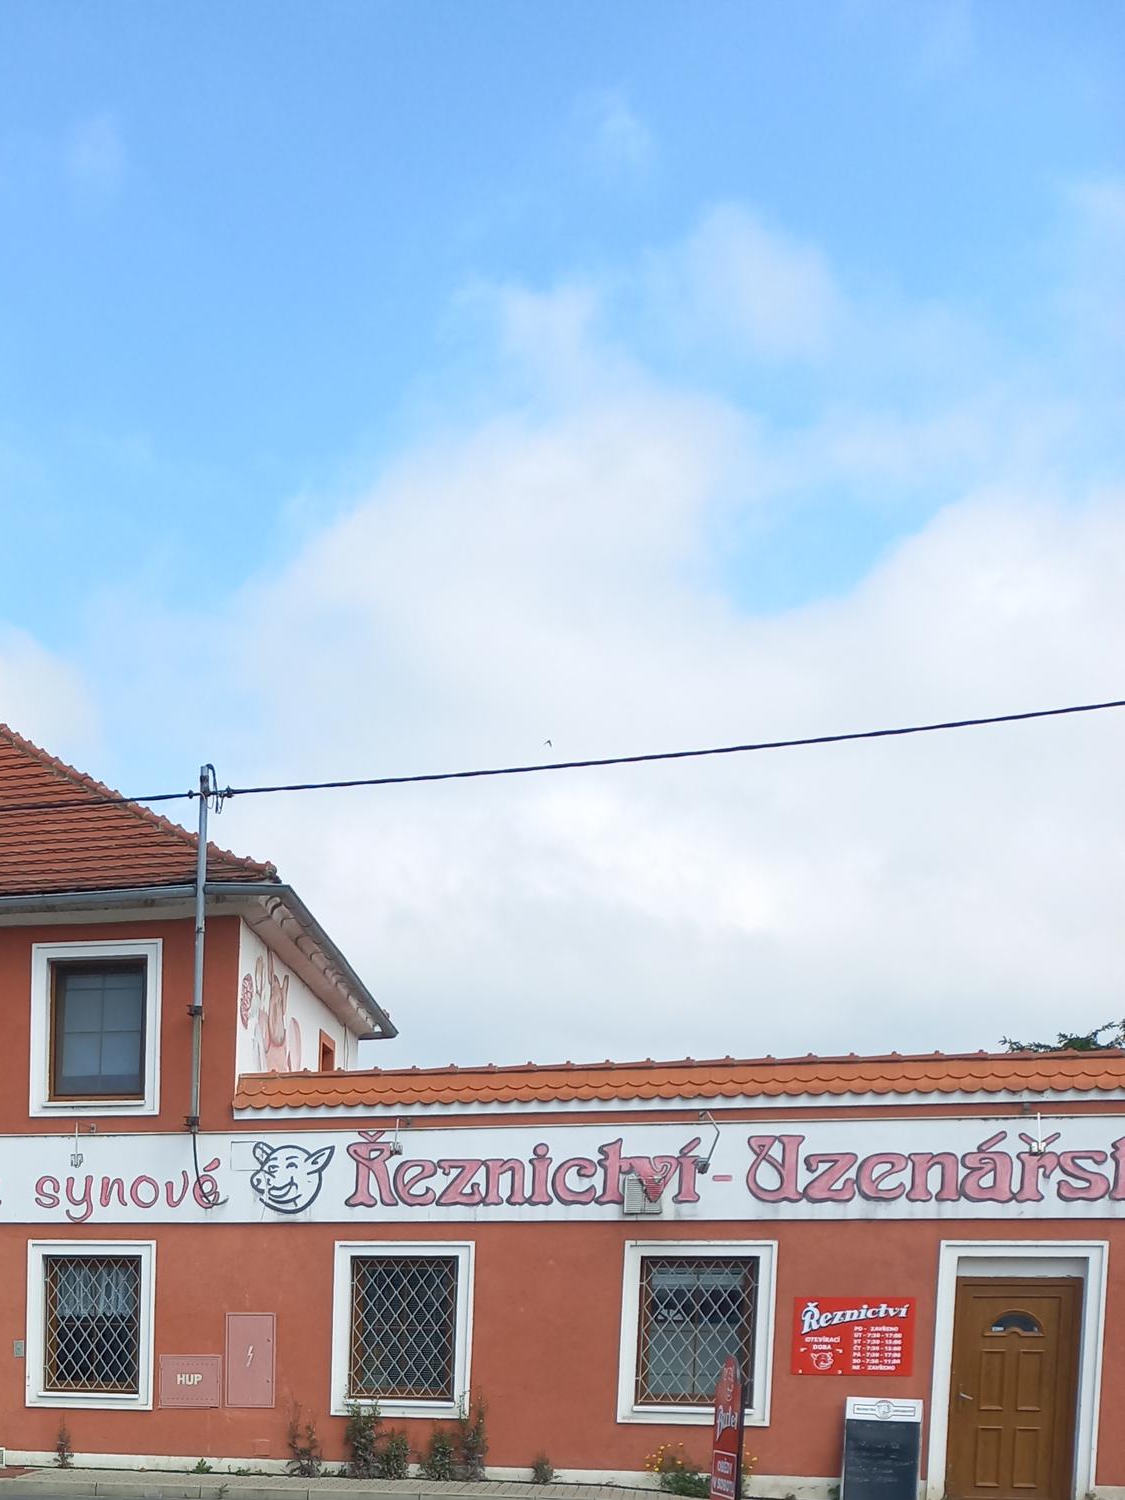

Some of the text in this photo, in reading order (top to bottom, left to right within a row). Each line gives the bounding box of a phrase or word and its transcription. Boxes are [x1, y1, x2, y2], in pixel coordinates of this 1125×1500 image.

[34, 1157, 221, 1224] synové
[801, 1301, 910, 1335] Řeznictví
[176, 1373, 203, 1385] HUP
